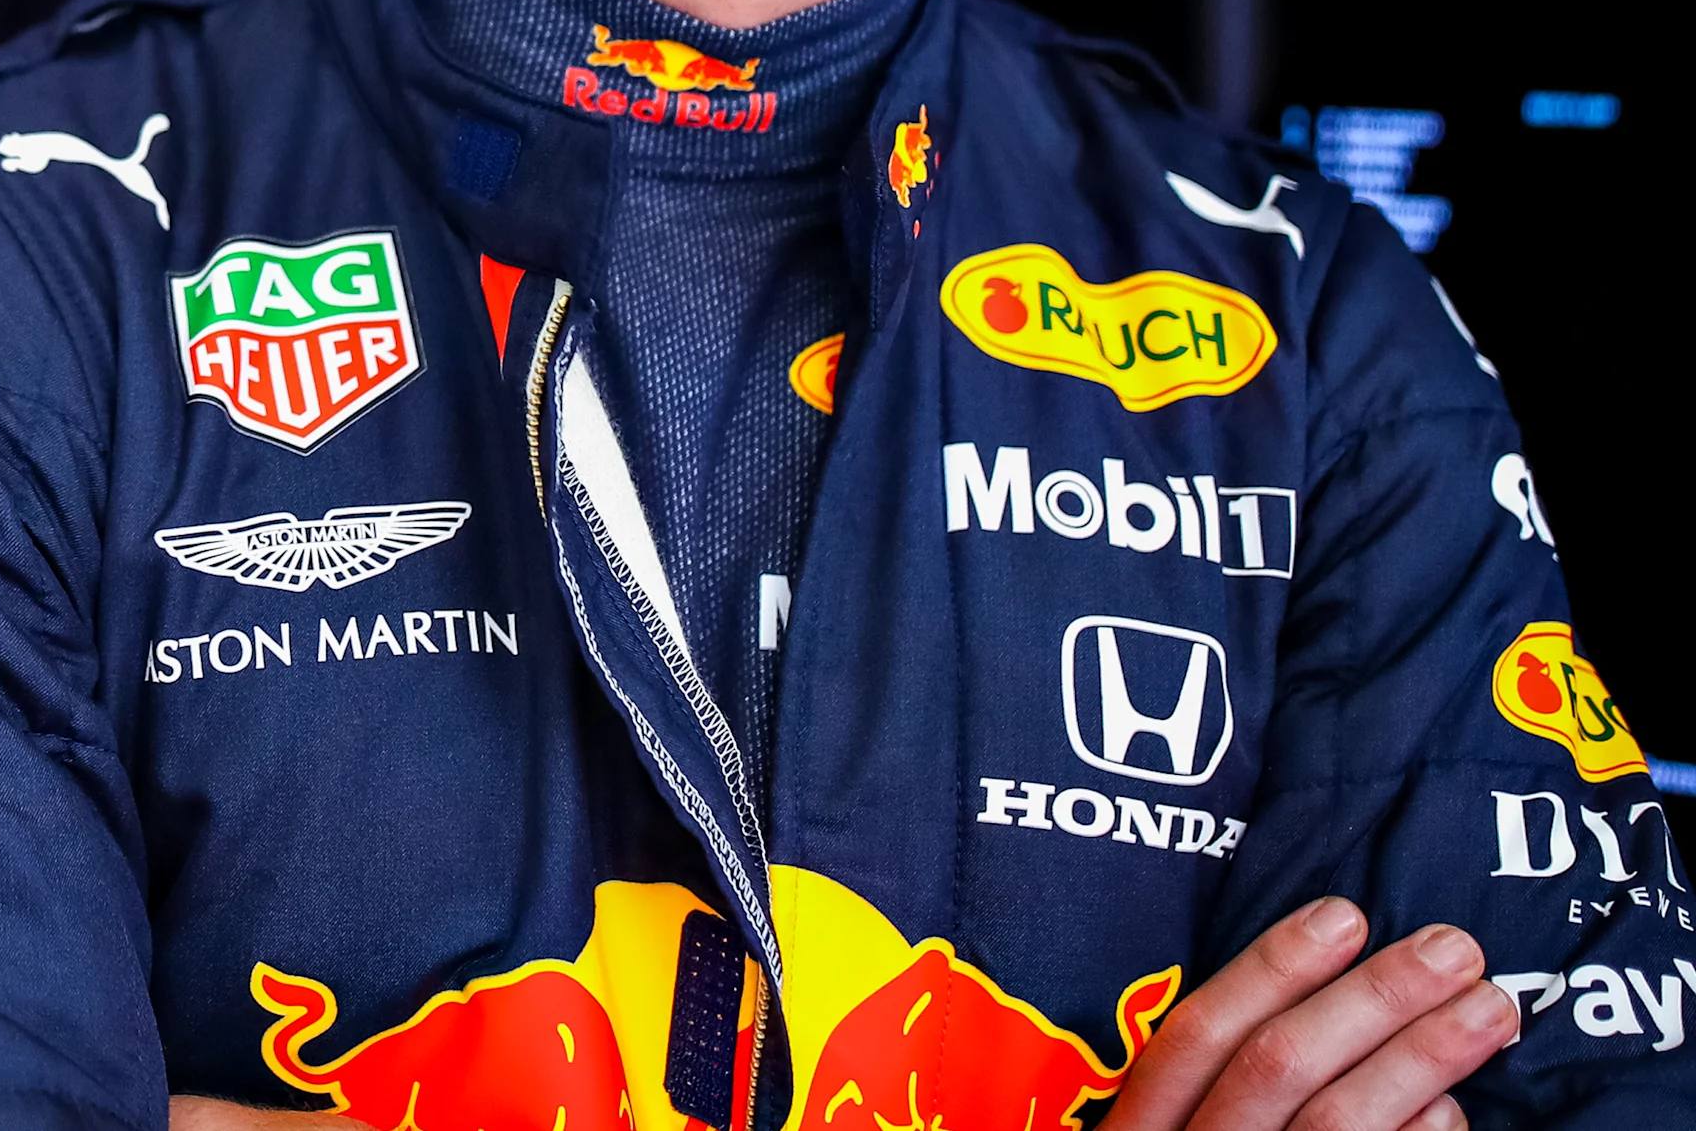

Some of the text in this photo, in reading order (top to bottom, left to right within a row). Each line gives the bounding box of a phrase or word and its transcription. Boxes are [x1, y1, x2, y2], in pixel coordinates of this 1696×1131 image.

[562, 67, 777, 133] Red Bull
[195, 251, 381, 319] TAG
[196, 326, 400, 429] HEUER
[247, 522, 377, 551] ASTON MARTIN
[943, 442, 1222, 564] Mobil
[144, 609, 519, 684] ASTON MARTIN
[976, 777, 1248, 861] HONDA
[1491, 957, 1696, 1053] Pay
